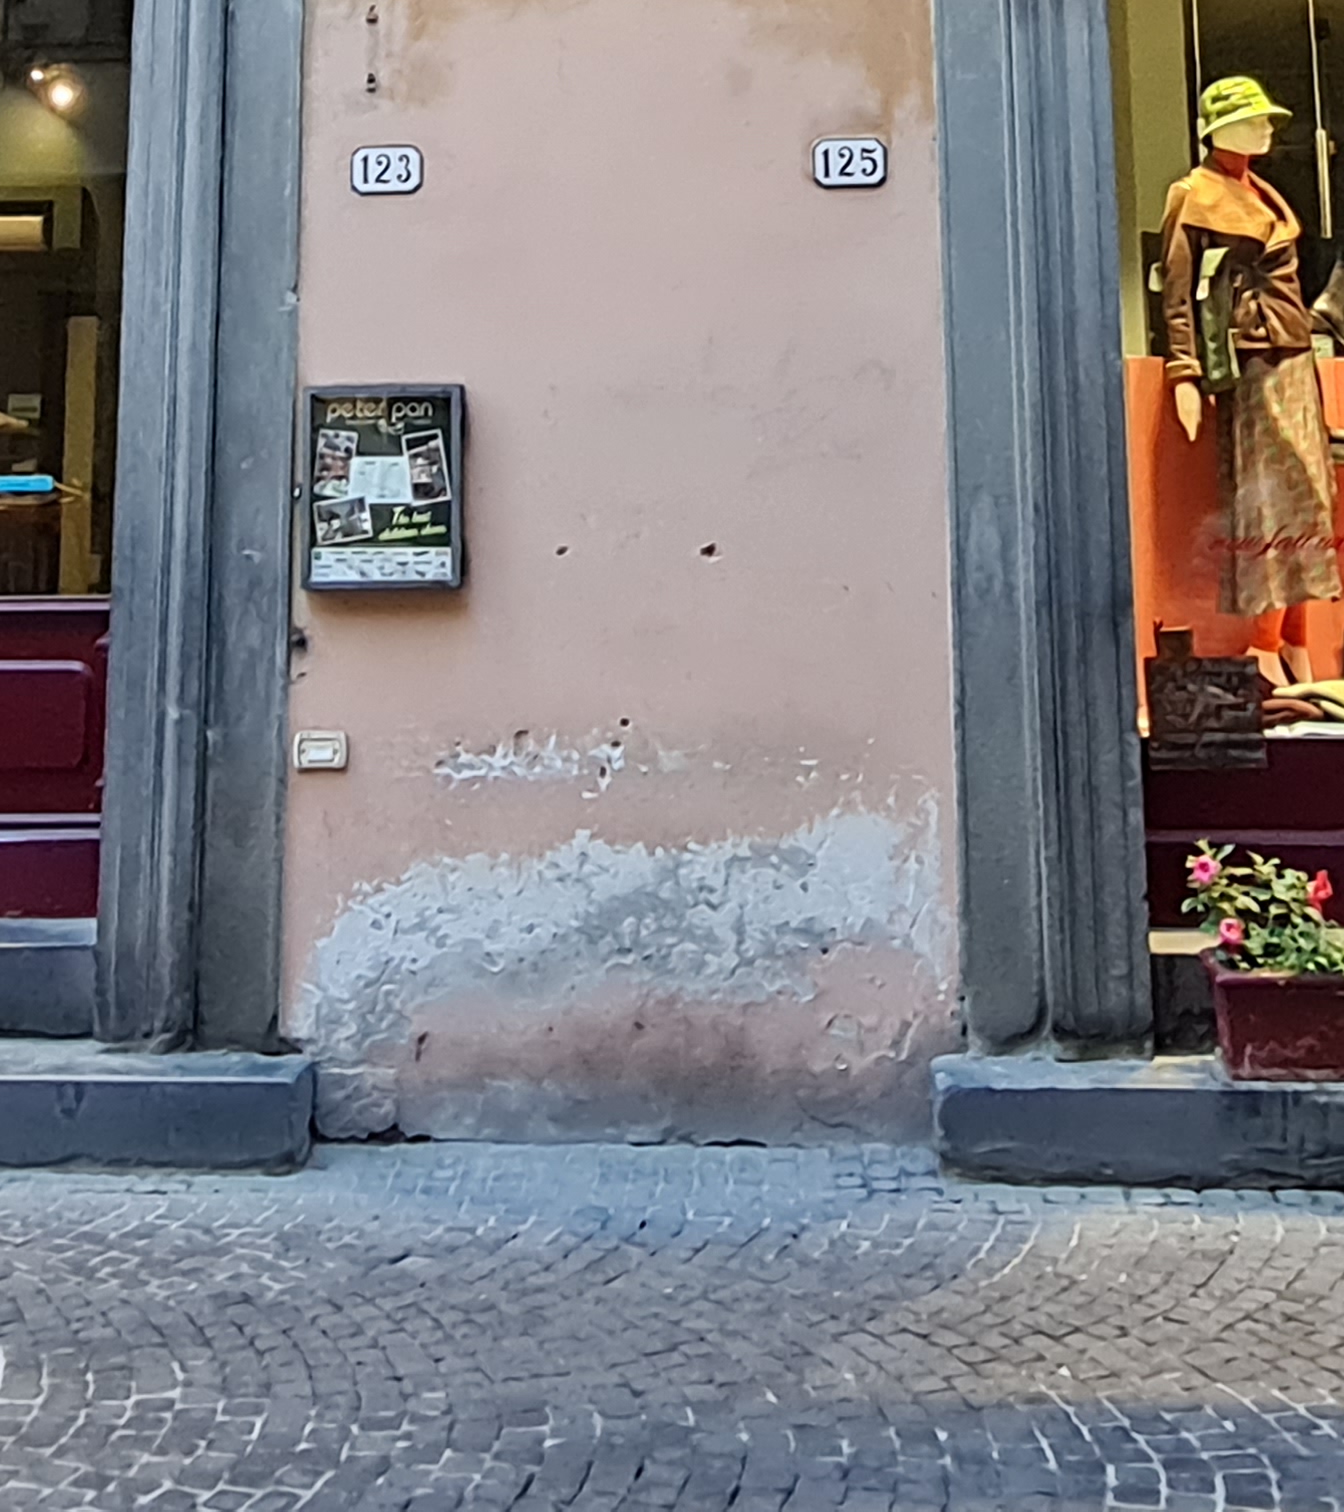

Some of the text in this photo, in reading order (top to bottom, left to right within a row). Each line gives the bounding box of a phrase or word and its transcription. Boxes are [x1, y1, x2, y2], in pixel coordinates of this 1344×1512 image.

[359, 153, 413, 185] 123
[820, 146, 878, 179] 125
[325, 399, 433, 423] peter pan
